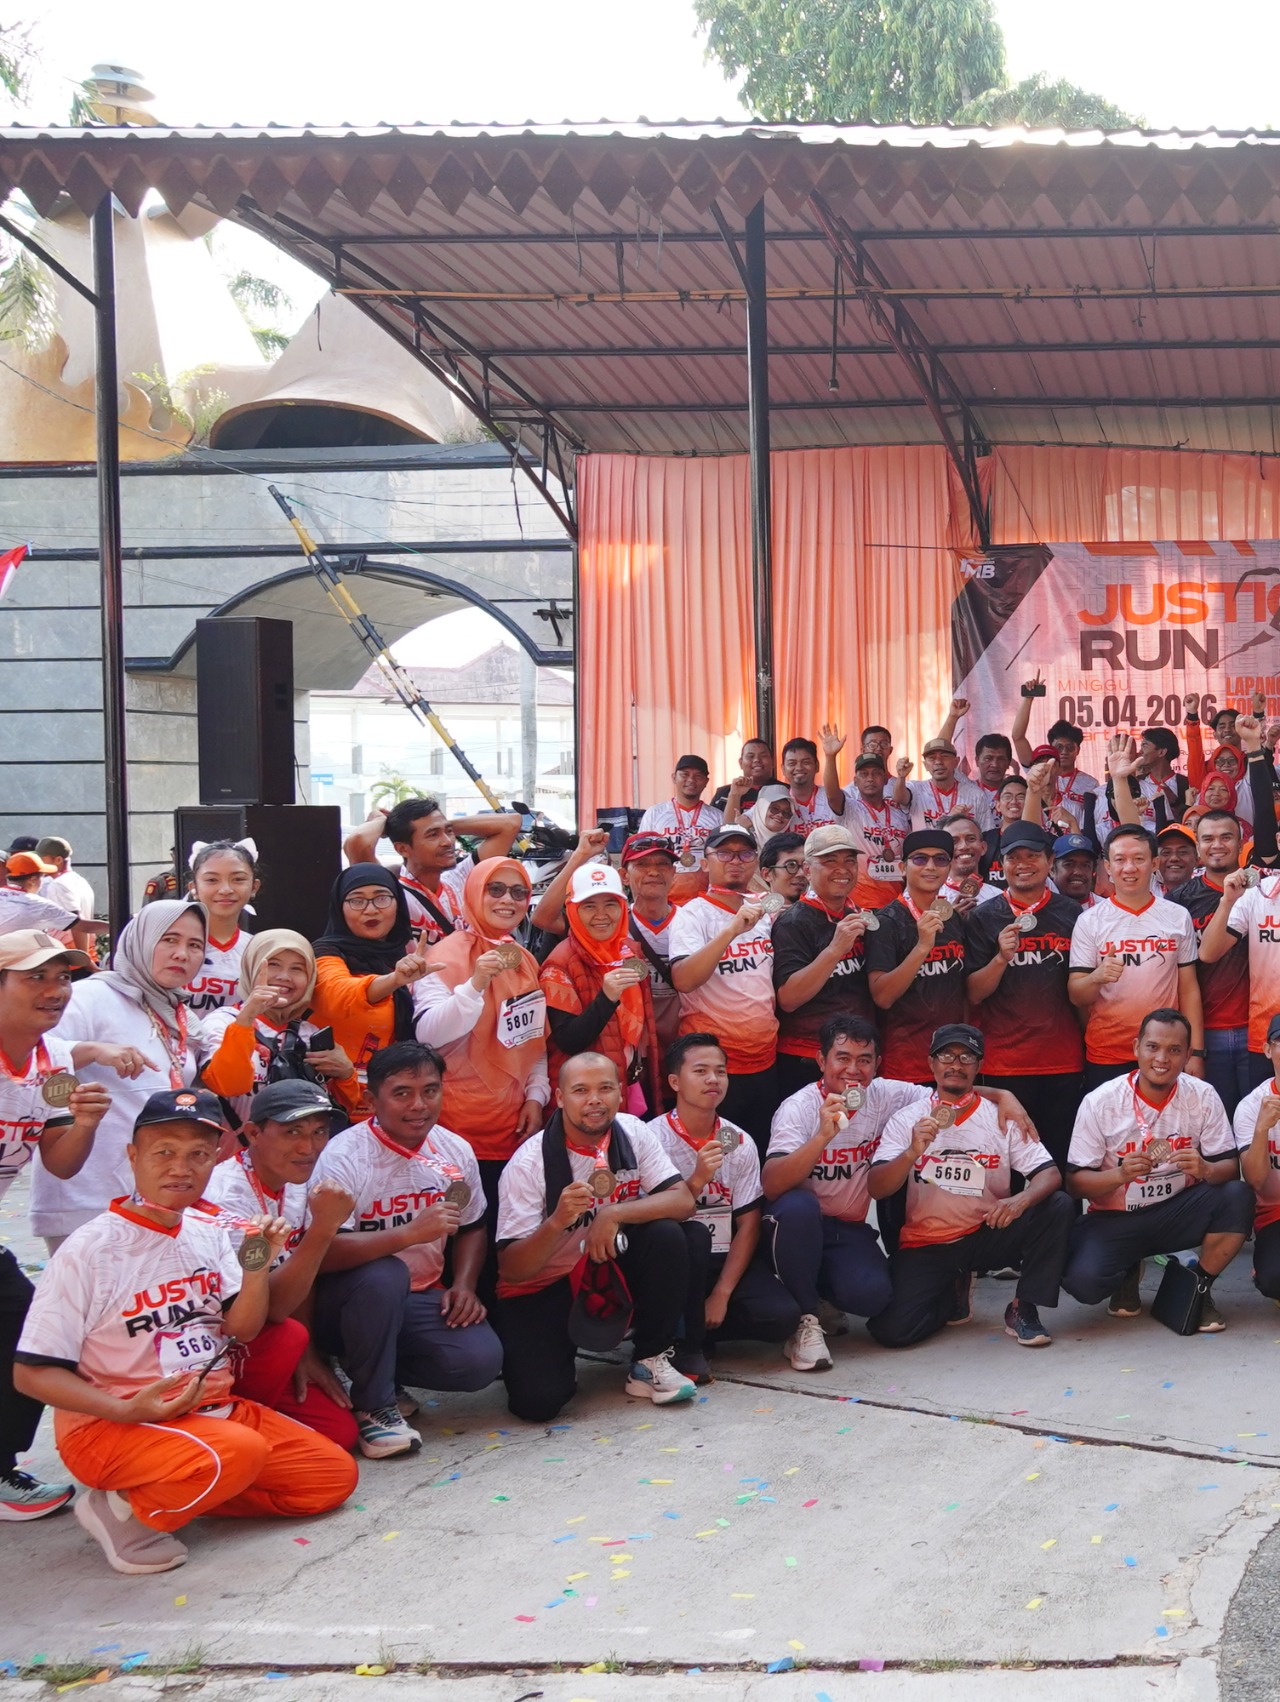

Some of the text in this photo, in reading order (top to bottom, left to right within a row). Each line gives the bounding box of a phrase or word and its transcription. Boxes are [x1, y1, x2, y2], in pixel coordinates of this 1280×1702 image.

[1080, 628, 1219, 671] RUN
[1058, 679, 1130, 691] MINGGU
[1059, 694, 1217, 729] 05.04.206
[875, 864, 895, 873] 5480
[1099, 939, 1178, 955] JUSTICE
[719, 955, 758, 976] RUN
[188, 993, 225, 1010] UN
[506, 1010, 535, 1031] 5807
[174, 1104, 197, 1112] PKS
[935, 1166, 971, 1182] 5650
[1140, 1183, 1173, 1198] 1228
[245, 1247, 264, 1263] 5K
